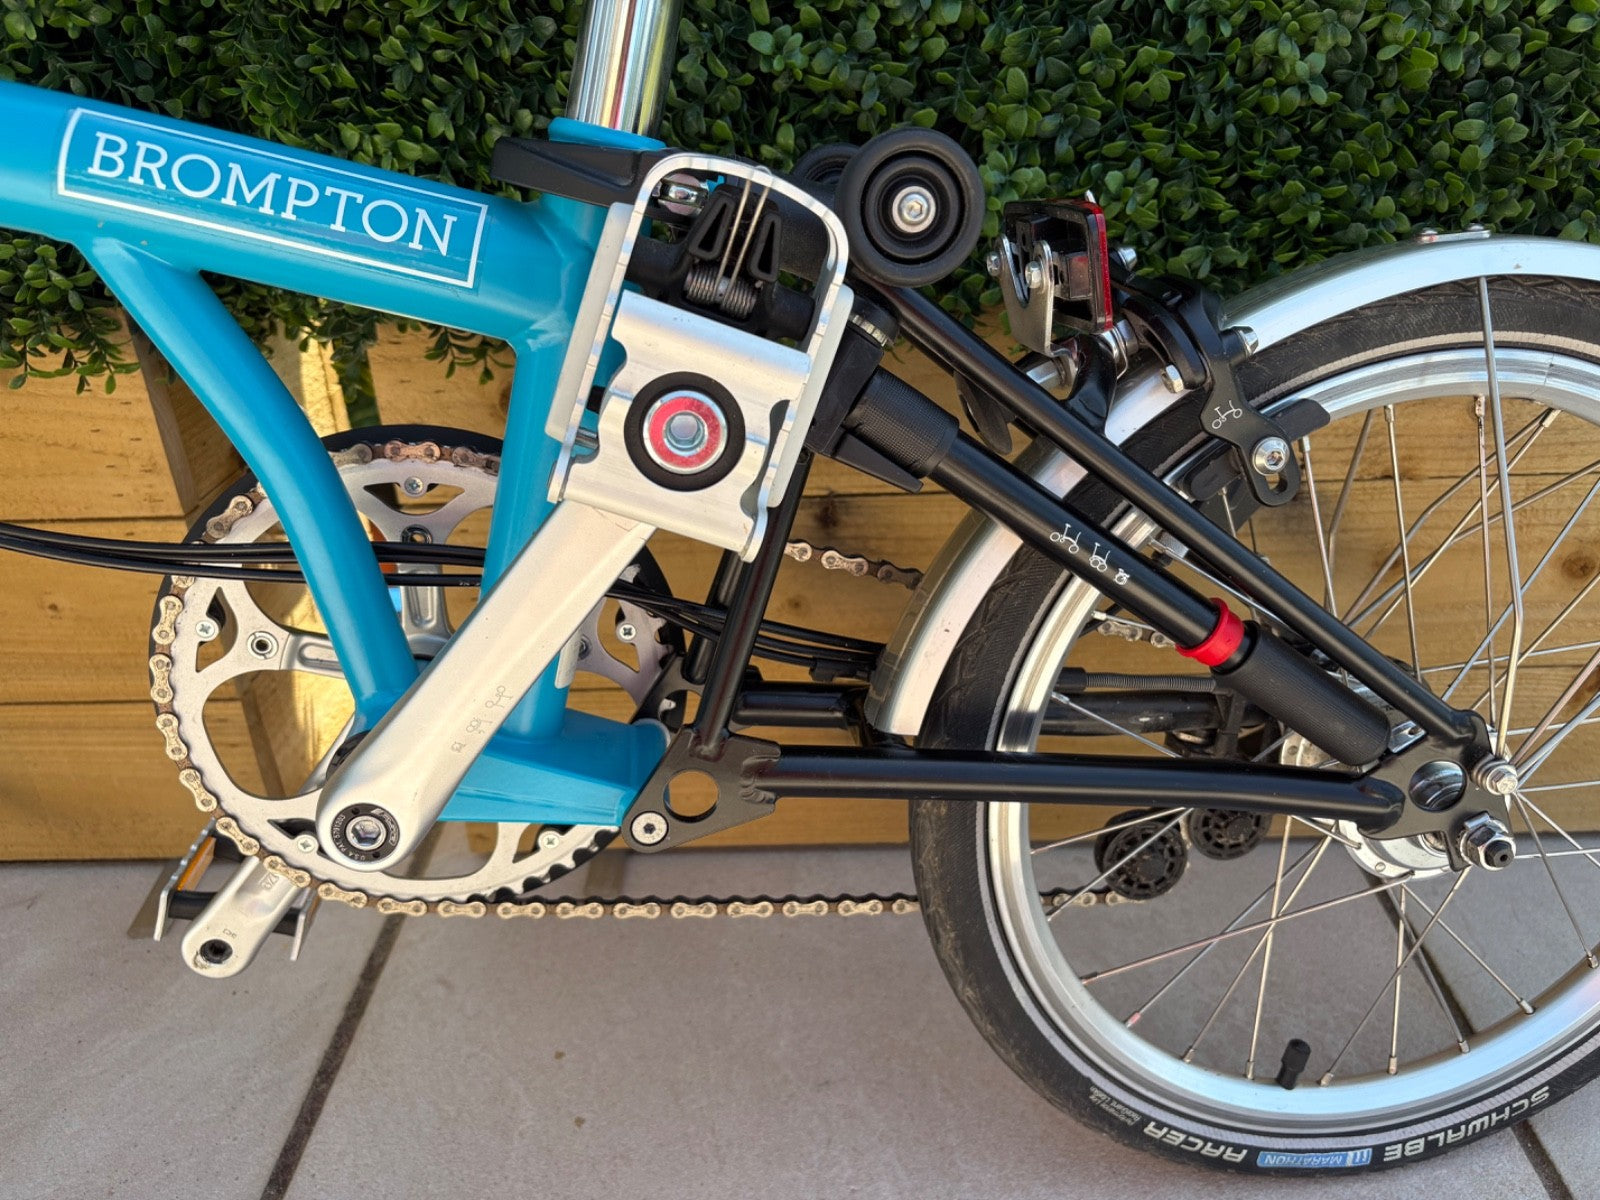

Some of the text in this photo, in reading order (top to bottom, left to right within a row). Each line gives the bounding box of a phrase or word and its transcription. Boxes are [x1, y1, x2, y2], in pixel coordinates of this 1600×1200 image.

[87, 131, 457, 256] BROMPTON
[1143, 1121, 1248, 1163] RACER
[1383, 1085, 1550, 1162] SCHWALBE
[1263, 1154, 1343, 1166] MARATHON
